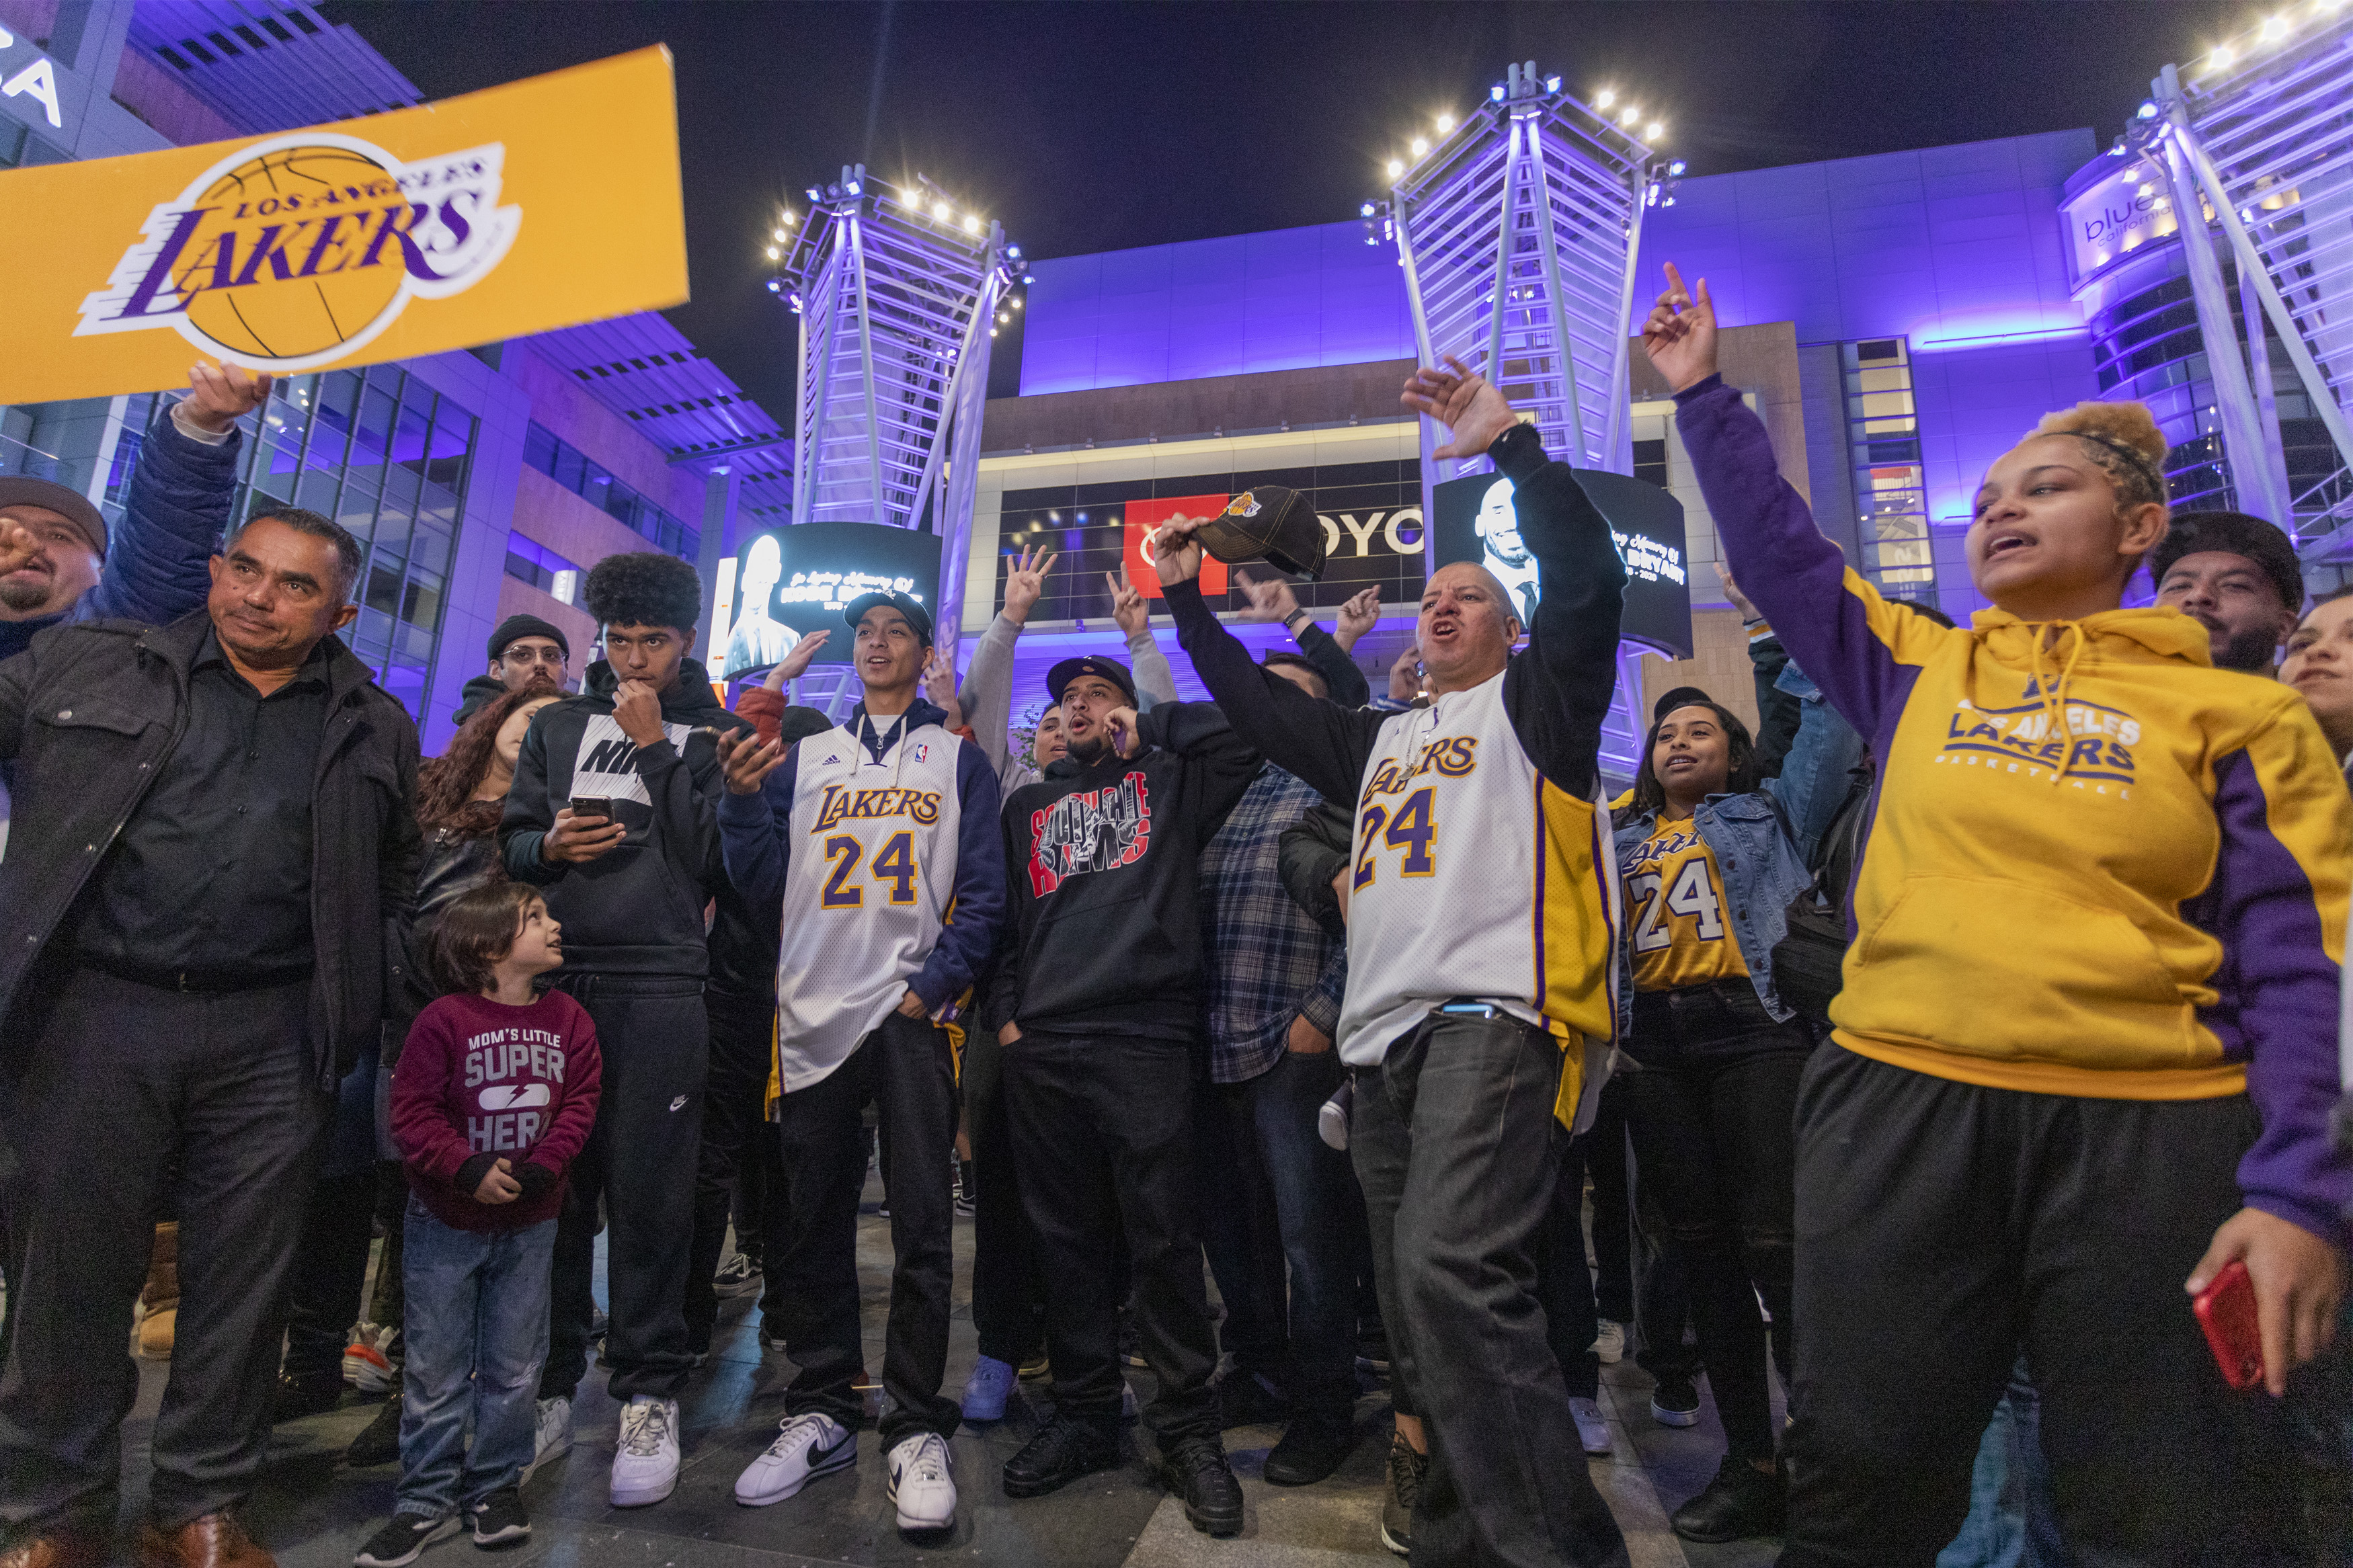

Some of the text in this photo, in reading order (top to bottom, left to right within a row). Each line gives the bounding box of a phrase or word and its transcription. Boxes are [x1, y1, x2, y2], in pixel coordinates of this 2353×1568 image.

[233, 194, 305, 220] LOS
[2085, 194, 2155, 243] blue
[2098, 207, 2171, 247] california
[99, 190, 485, 321] LAKERS
[1627, 548, 1685, 585] BRYANT
[1948, 712, 2135, 770] LAKERS
[809, 784, 943, 835] LAKERS
[1028, 818, 1151, 899] RAMS
[1353, 786, 1439, 896] 24
[821, 830, 918, 910] 24
[1626, 856, 1725, 954] 24
[469, 1028, 561, 1050] MOM'S LITTLE
[465, 1044, 565, 1088] SUPER
